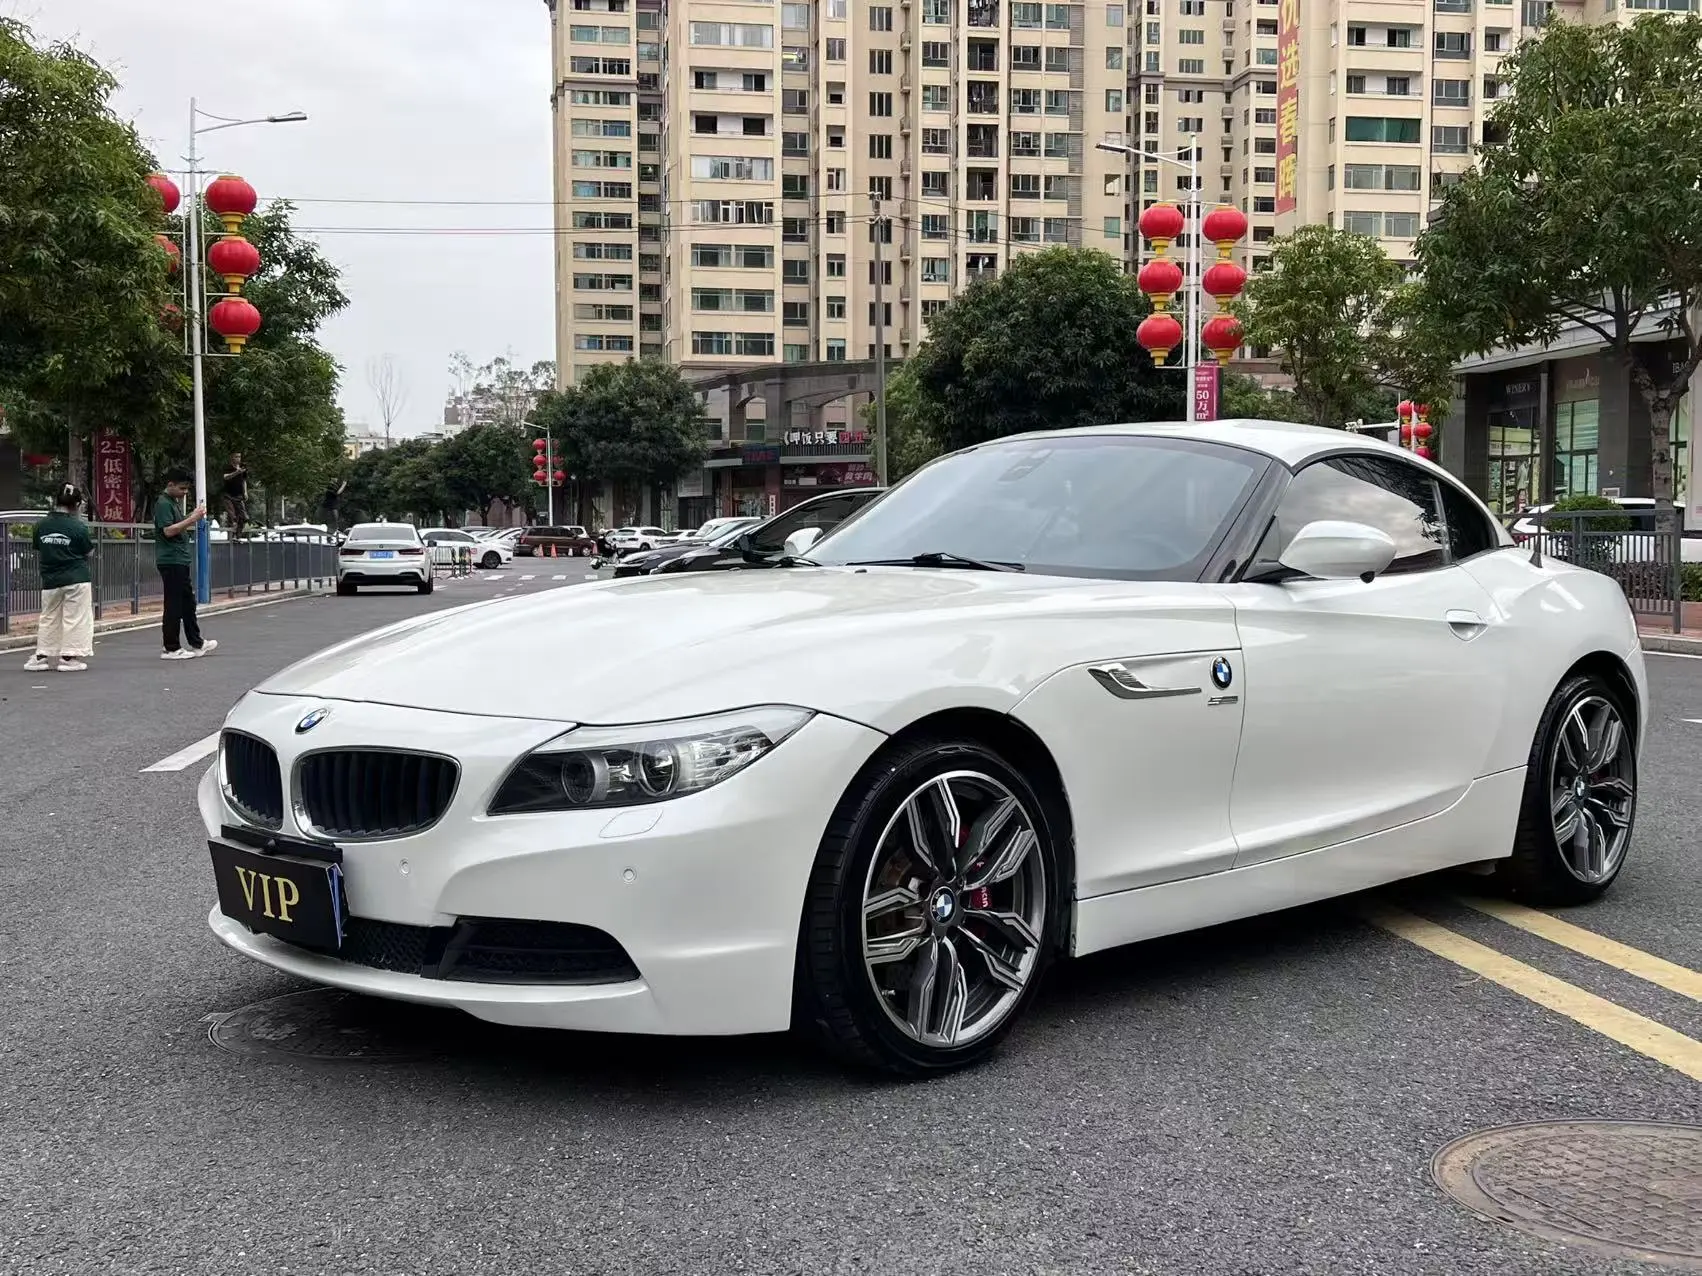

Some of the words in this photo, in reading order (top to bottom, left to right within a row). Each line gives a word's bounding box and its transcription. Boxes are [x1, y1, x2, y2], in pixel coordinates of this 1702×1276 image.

[1196, 390, 1209, 400] 50
[1197, 400, 1208, 411] 万
[235, 865, 300, 922] VIP
